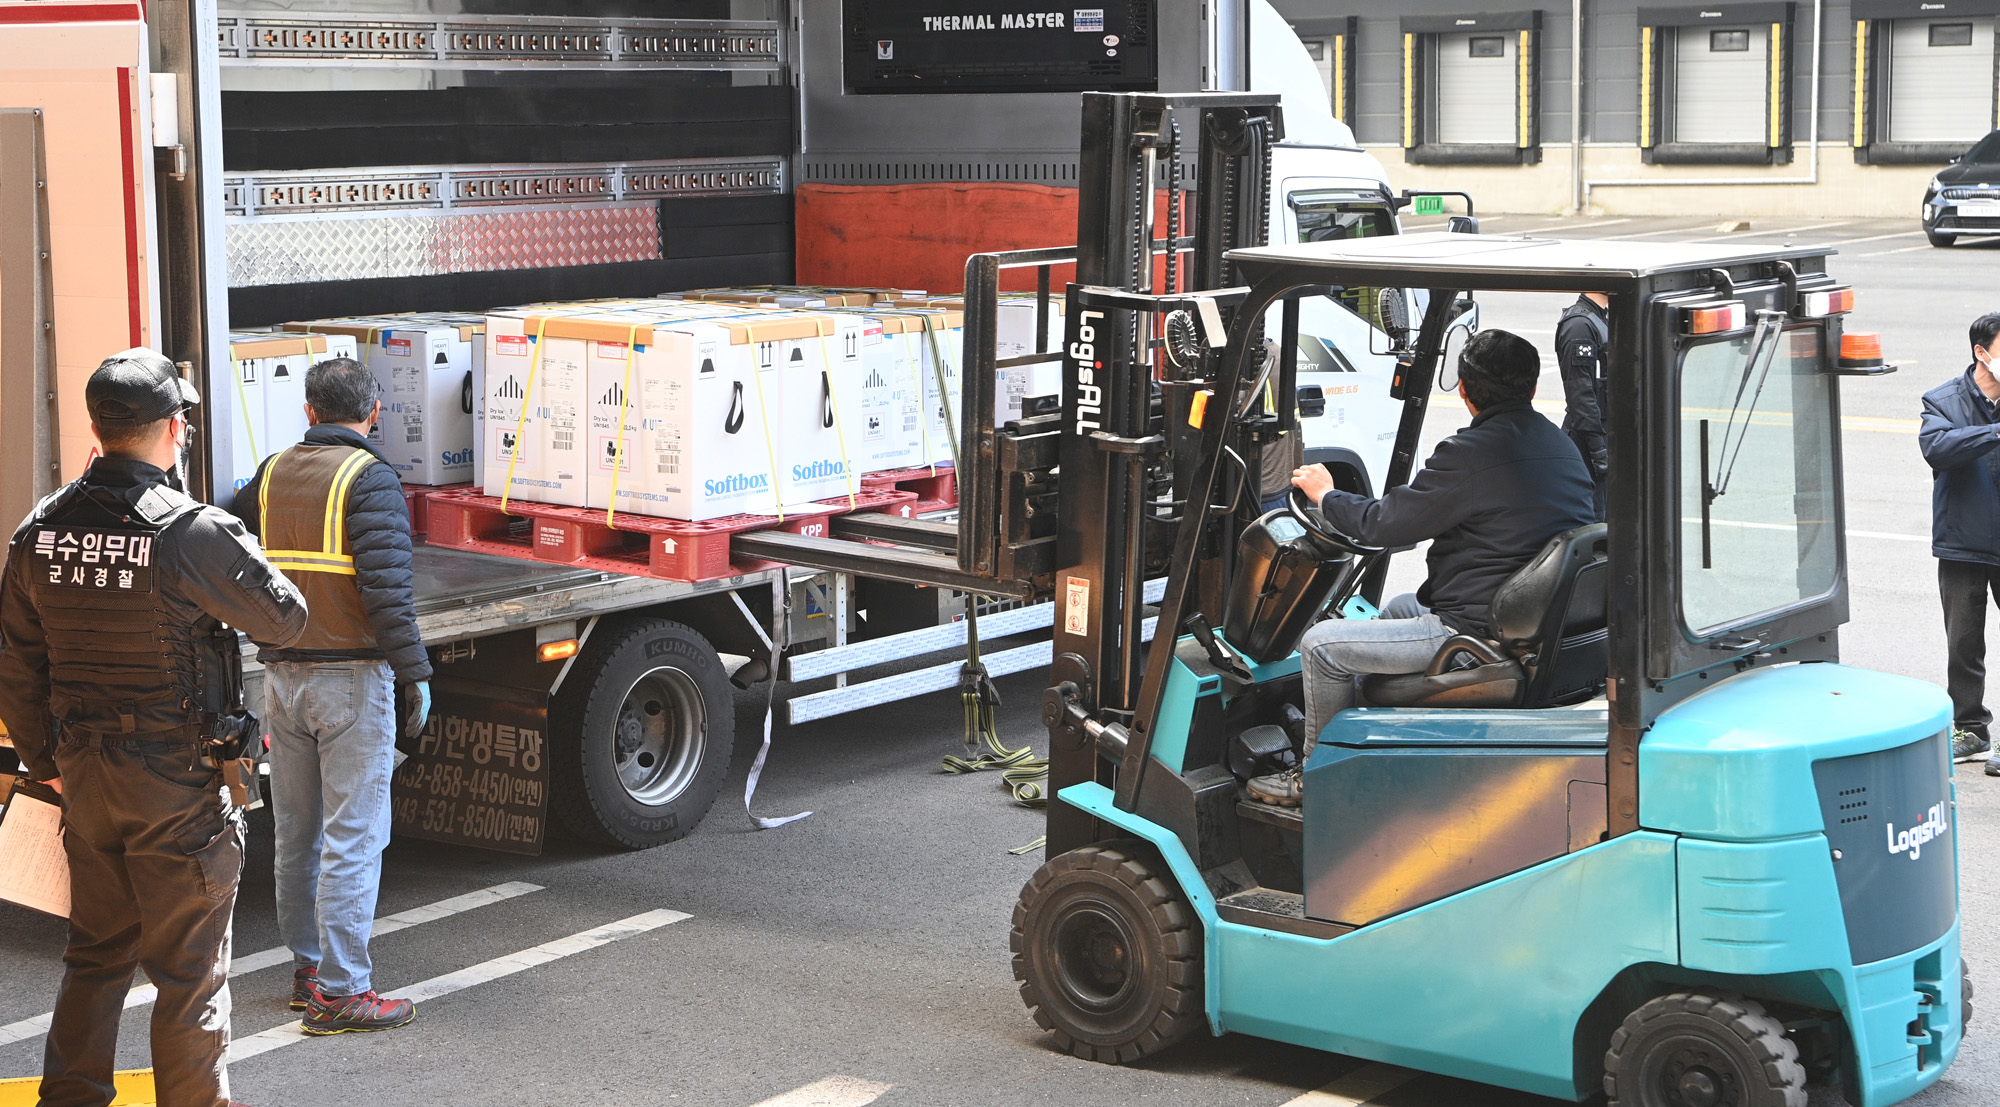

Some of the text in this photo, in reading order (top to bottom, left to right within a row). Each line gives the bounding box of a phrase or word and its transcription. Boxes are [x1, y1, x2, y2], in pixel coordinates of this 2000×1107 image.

[923, 14, 995, 31] THERMAL
[1001, 12, 1065, 29] MASTER
[1070, 310, 1104, 435] LogisALL
[1325, 387, 1344, 395] WIDE
[792, 459, 852, 482] Softbox
[704, 473, 768, 497] Softbox
[801, 523, 823, 537] KPP
[35, 530, 152, 567] 특수임무대
[650, 640, 706, 668] KUMHO
[1886, 800, 1947, 861] LogisALL
